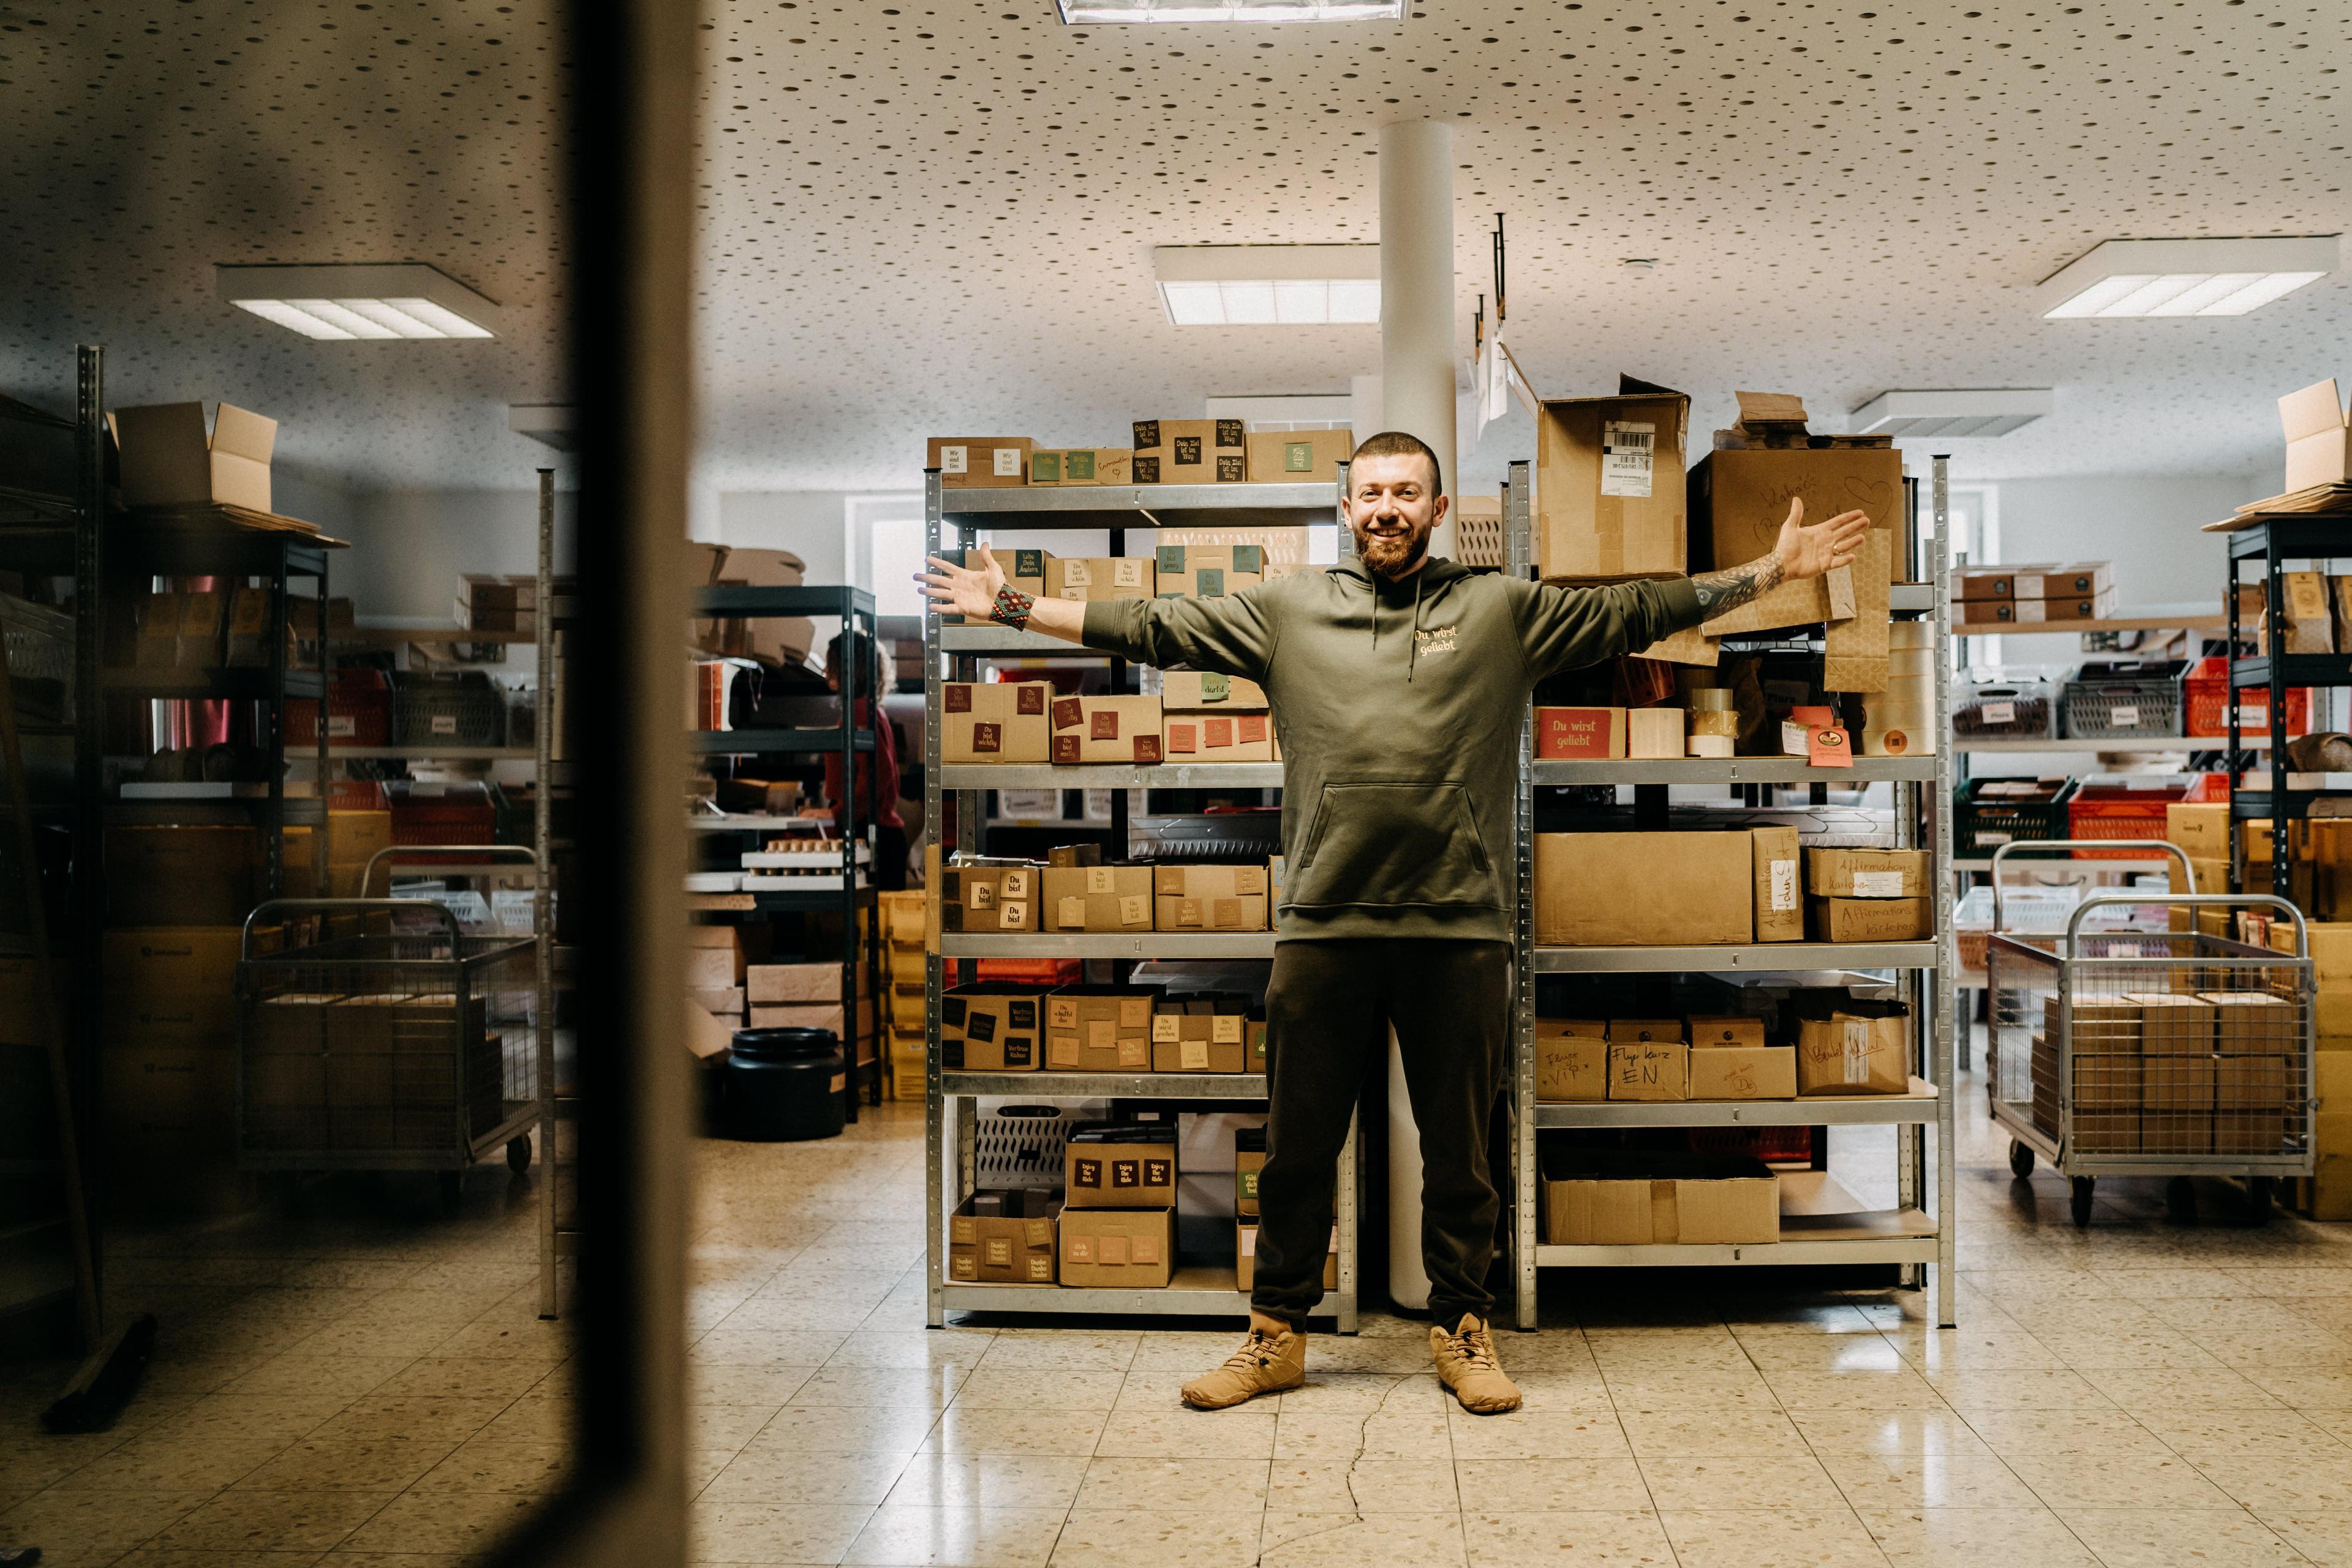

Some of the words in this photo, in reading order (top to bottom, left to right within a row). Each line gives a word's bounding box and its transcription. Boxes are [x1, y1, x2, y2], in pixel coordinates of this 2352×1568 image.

[1224, 435, 1235, 444] Weg
[1415, 630, 1430, 641] Du
[1433, 625, 1457, 638] wirst
[1420, 639, 1456, 657] geliebt
[1205, 685, 1225, 693] darfst
[1553, 720, 1567, 731] Du
[1570, 720, 1596, 731] wirst
[978, 739, 997, 747] wichtig
[1557, 734, 1591, 748] geliebt
[1839, 859, 1914, 873] Affirmations
[1545, 1053, 1578, 1067] Flyer
[1612, 1047, 1640, 1067] Flyer
[1813, 1042, 1844, 1064] Beutel
[1623, 1065, 1657, 1084] EN
